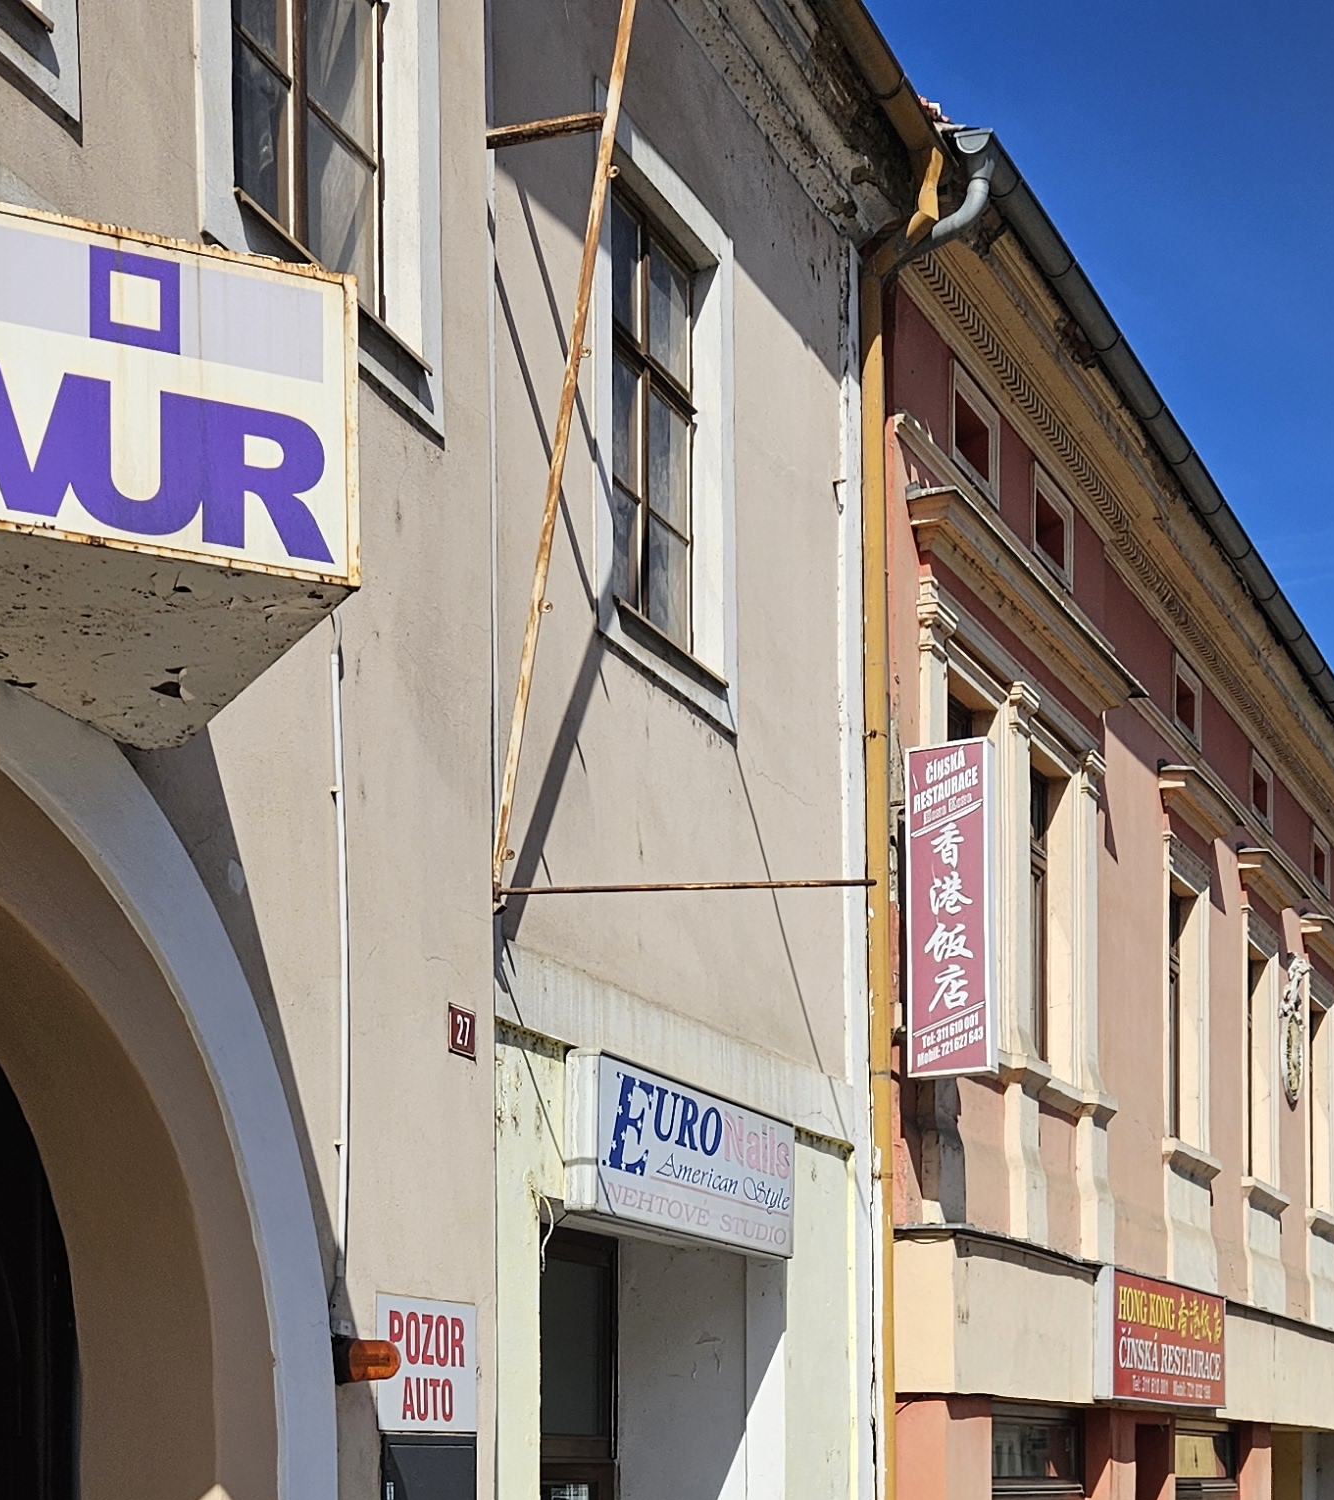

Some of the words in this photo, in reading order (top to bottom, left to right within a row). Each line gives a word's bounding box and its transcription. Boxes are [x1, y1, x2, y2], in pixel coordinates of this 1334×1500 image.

[925, 745, 966, 784] ČÍNSKÁ
[913, 764, 979, 815] RESTAURACE
[455, 1014, 472, 1047] 27
[655, 1153, 739, 1195] American
[742, 1176, 791, 1215] Style
[607, 1182, 711, 1227] NEHTOVÉ
[719, 1213, 787, 1246] STUDIO
[1118, 1285, 1148, 1325] HONG
[1148, 1293, 1176, 1331] KONG
[389, 1309, 465, 1368] POZOR
[1118, 1326, 1159, 1372] ČÍNSKÁ
[1160, 1343, 1222, 1381] RESTAURACE
[401, 1376, 454, 1423] AUTO
